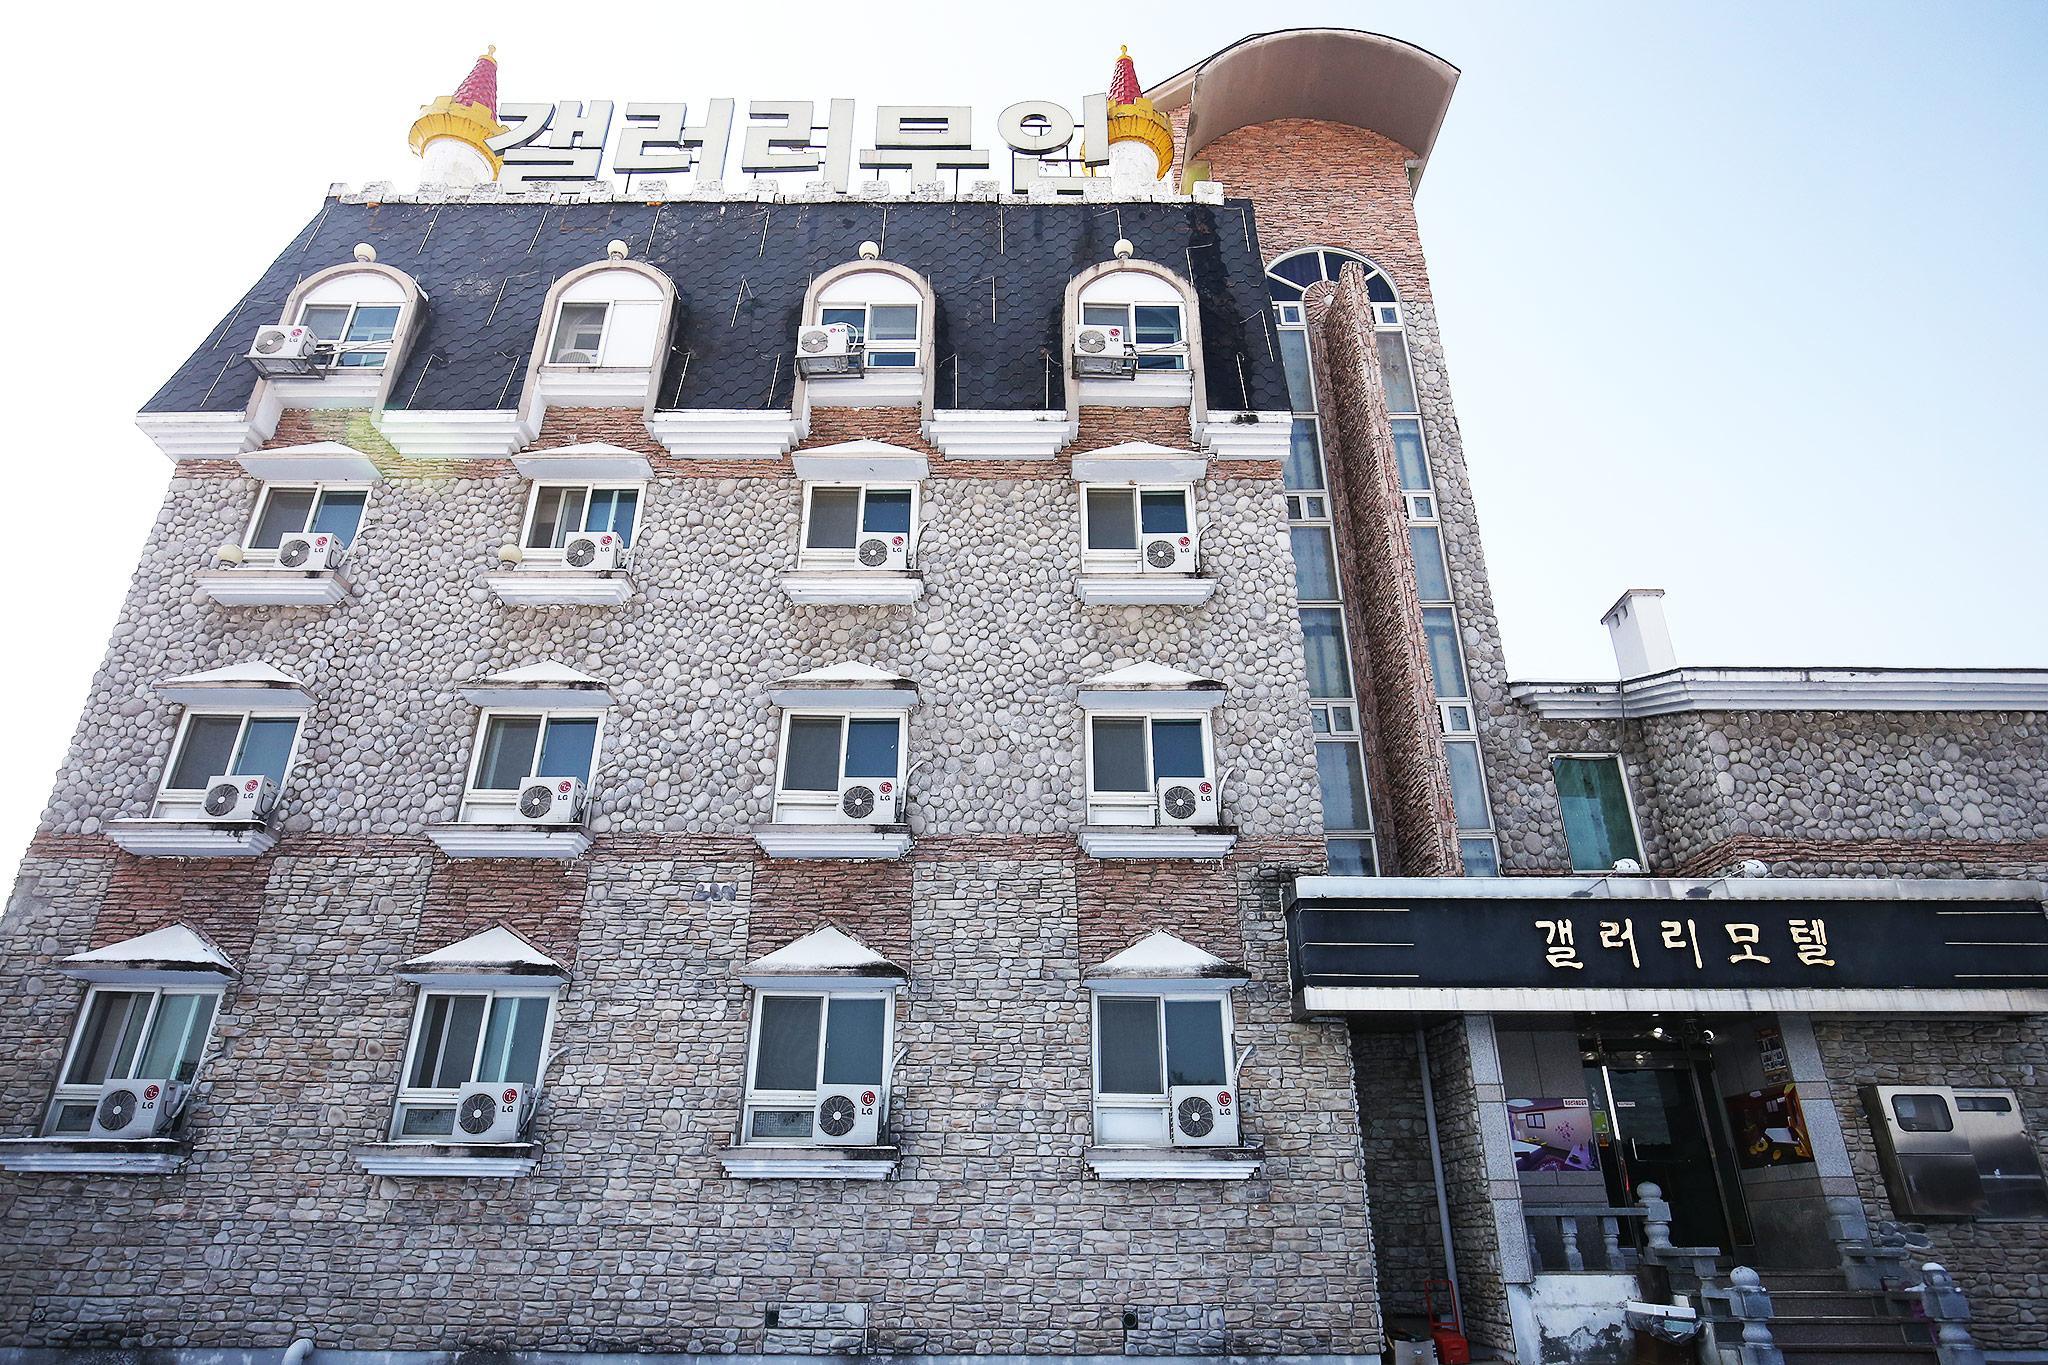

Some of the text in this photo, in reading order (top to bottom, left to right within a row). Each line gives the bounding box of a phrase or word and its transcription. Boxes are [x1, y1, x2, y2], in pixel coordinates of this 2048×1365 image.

[484, 93, 1112, 195] 갤러리무인
[1534, 917, 1836, 970] 갤러리모텔
[501, 1105, 514, 1113] LG
[1219, 1108, 1231, 1116] LG
